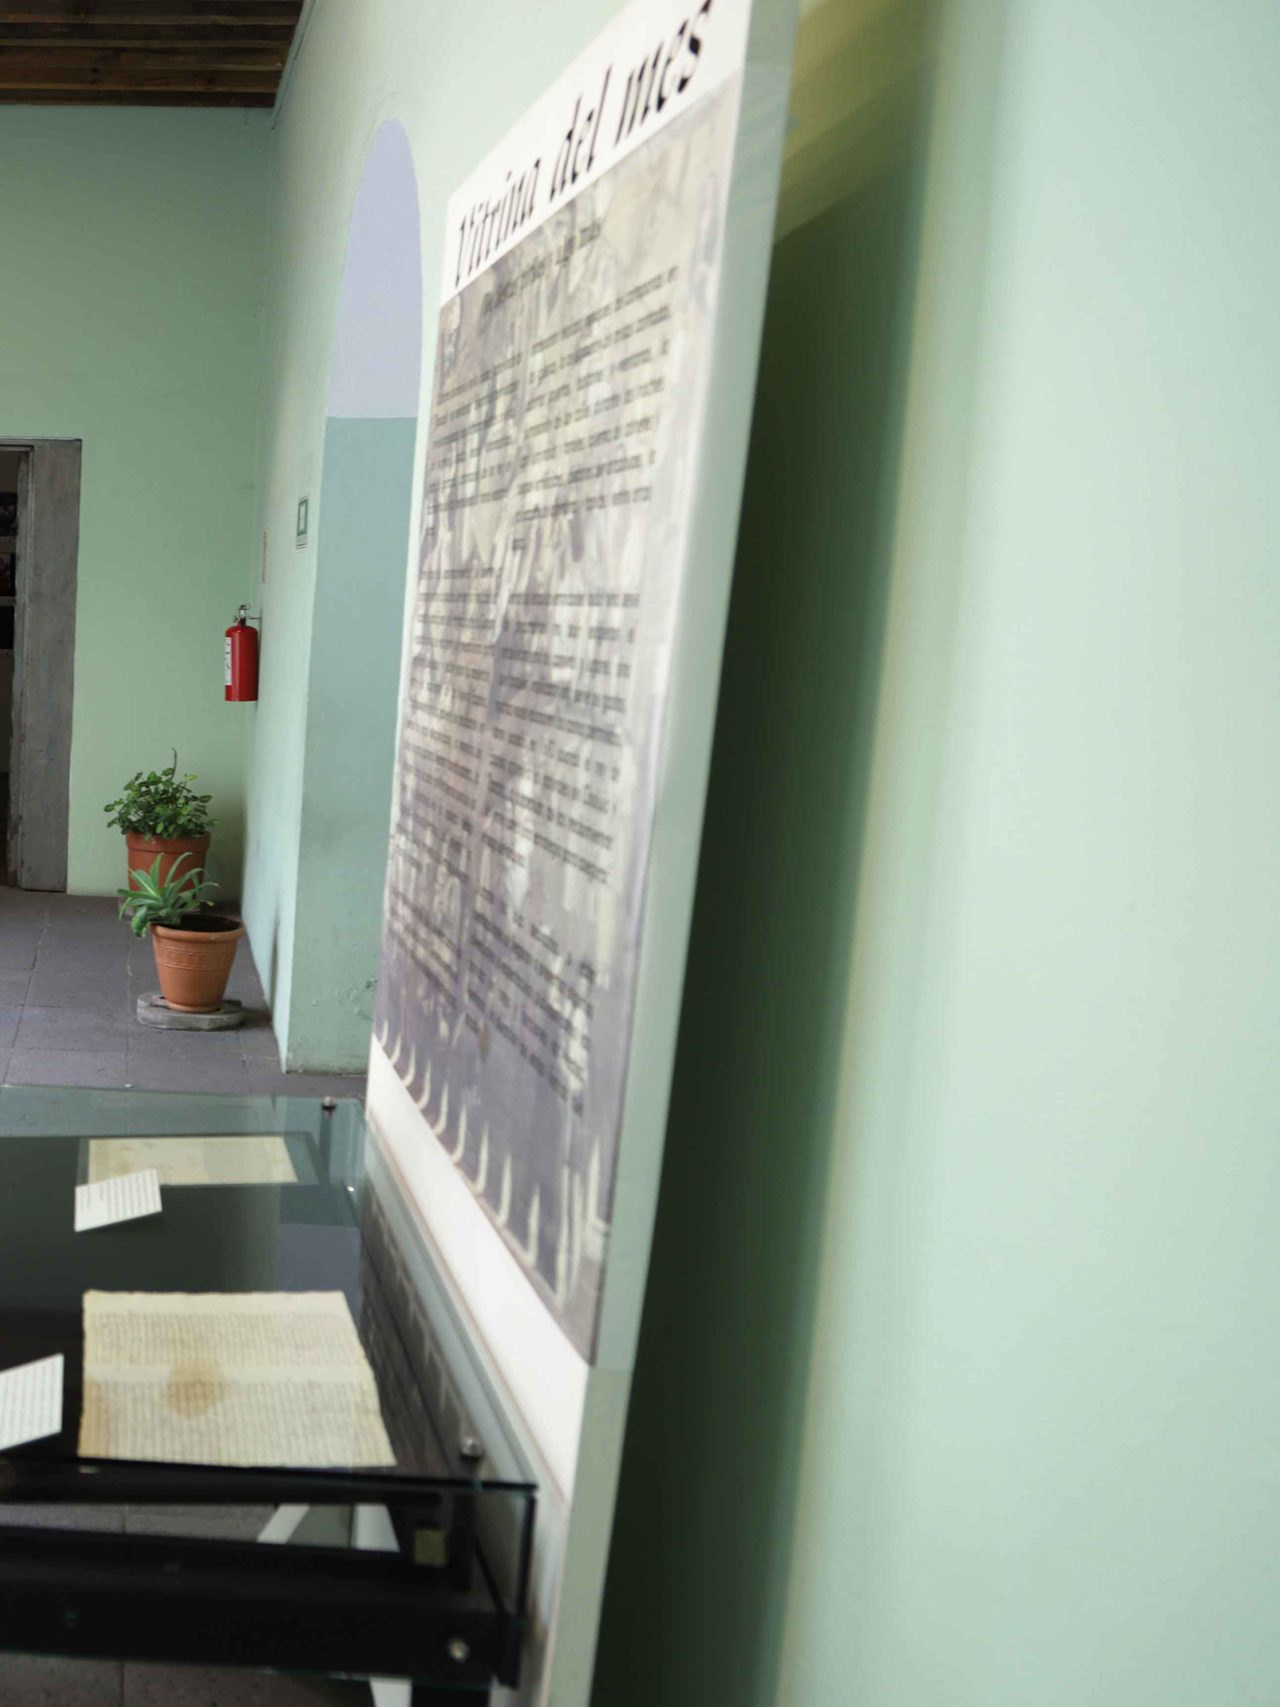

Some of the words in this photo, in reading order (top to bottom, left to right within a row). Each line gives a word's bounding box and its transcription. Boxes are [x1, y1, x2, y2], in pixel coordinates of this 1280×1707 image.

[454, 156, 542, 290] Vitrina
[549, 62, 613, 204] del
[613, 0, 714, 148] mes
